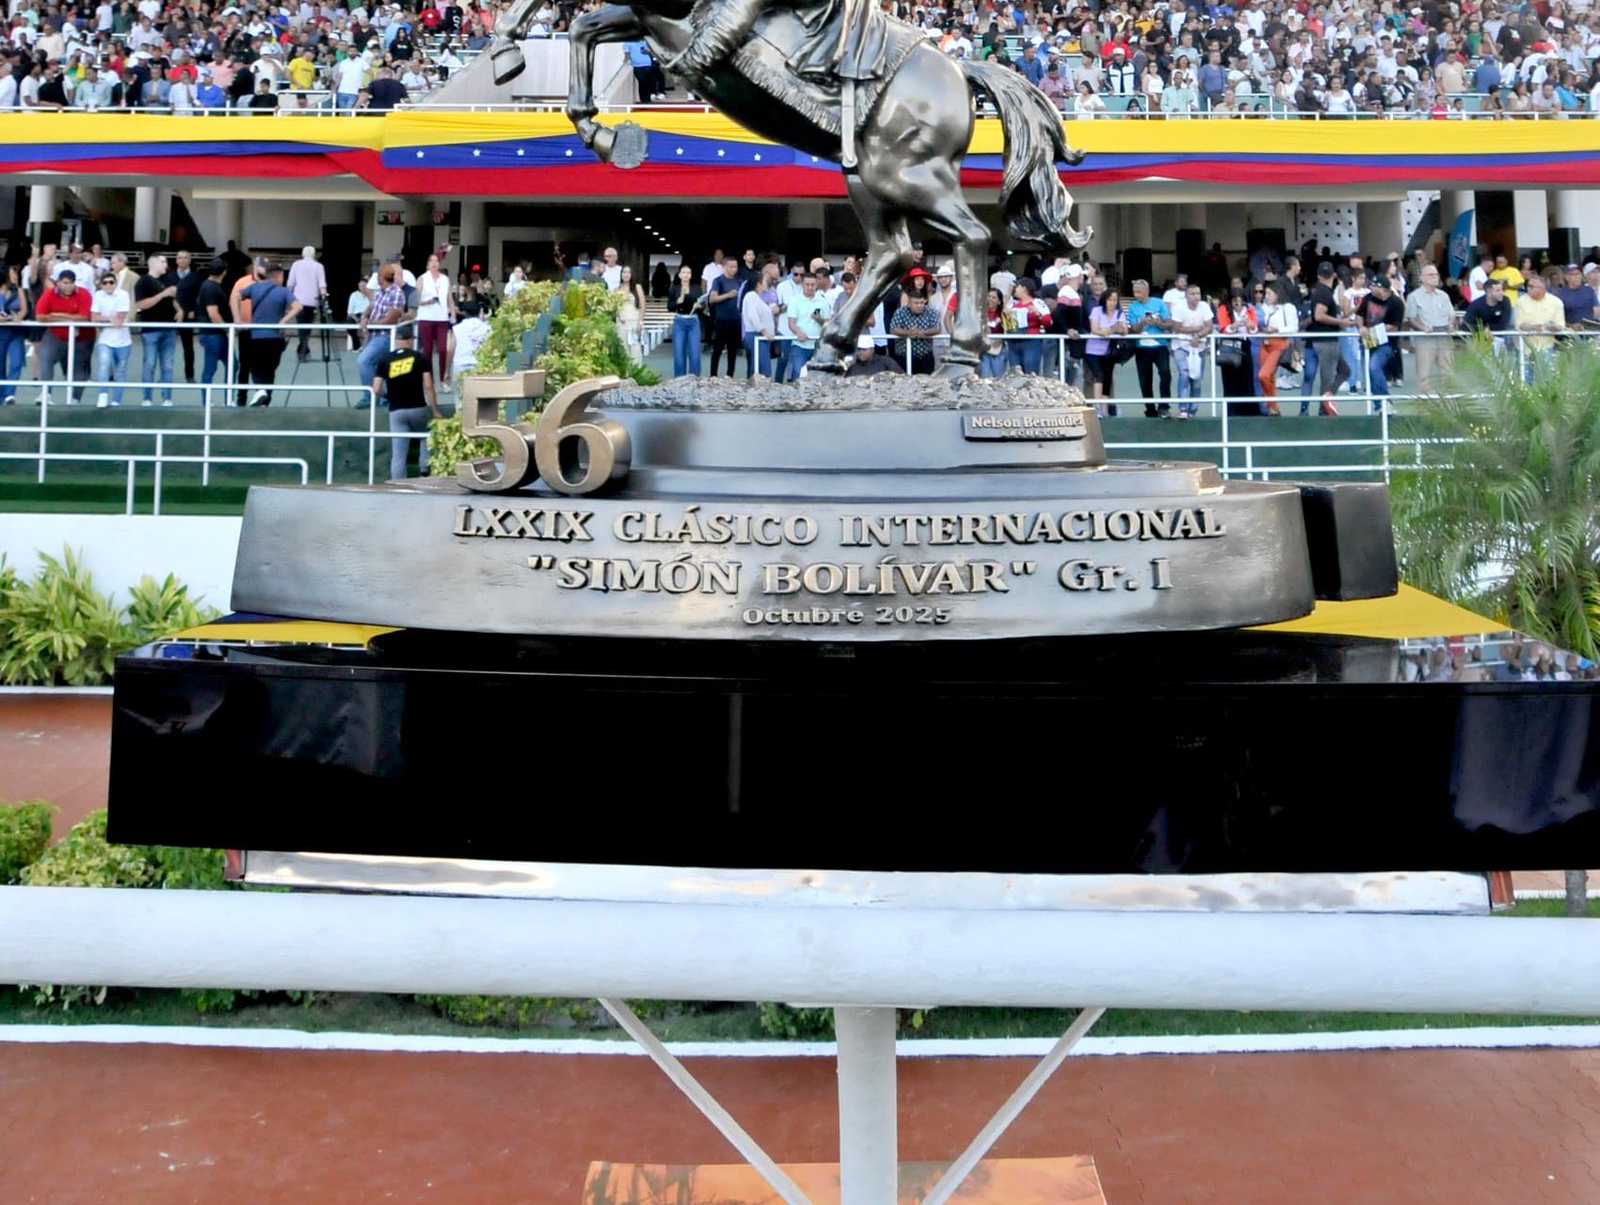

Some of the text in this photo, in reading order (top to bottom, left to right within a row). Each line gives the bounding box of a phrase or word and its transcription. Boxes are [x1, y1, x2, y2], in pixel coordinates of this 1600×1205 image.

[389, 356, 415, 379] 56
[456, 370, 632, 495] 56
[971, 416, 1021, 429] Nelson
[452, 505, 1227, 546] LXXIX CLÁSICO INTERNACIONAL
[526, 553, 1173, 595] "SIMÓN BOLÍVAR" Gr. I
[742, 607, 952, 624] Octubre 2025
